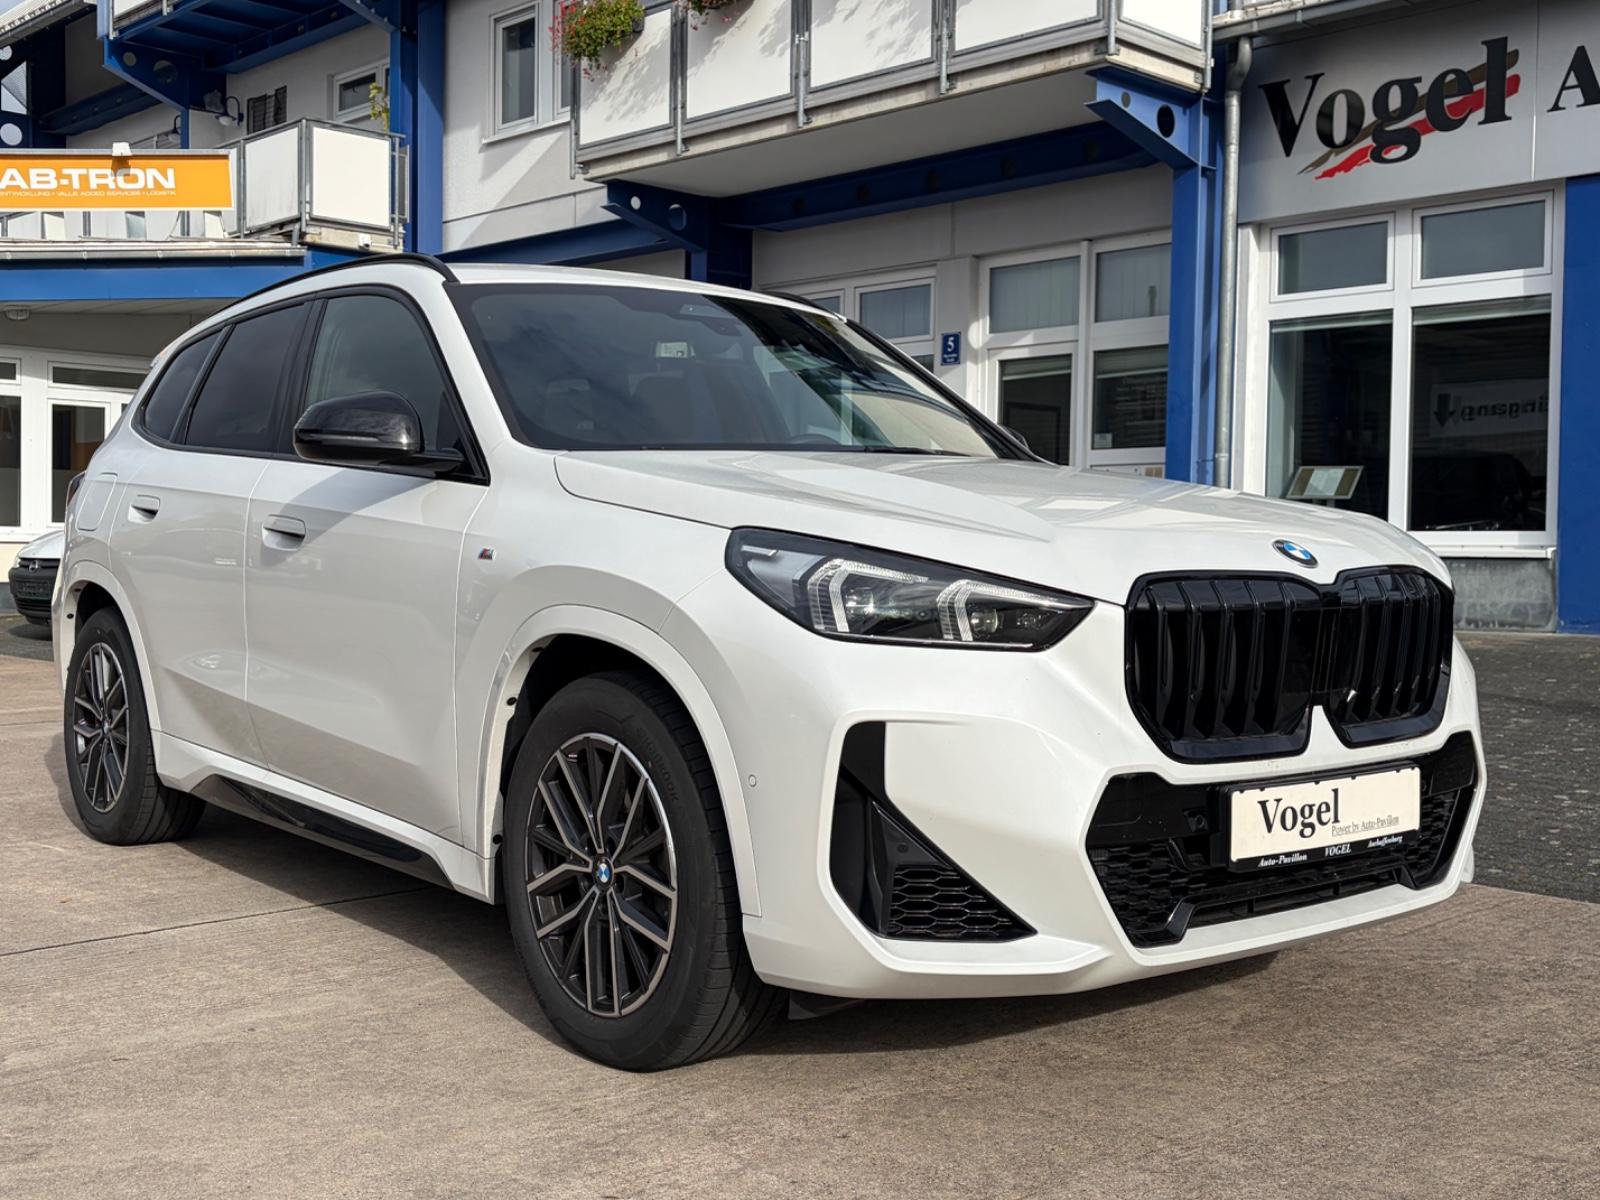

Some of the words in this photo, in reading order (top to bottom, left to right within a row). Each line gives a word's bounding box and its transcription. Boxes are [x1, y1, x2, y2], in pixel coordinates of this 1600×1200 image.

[1258, 36, 1512, 164] Vogel
[1546, 45, 1600, 113] A
[0, 167, 176, 190] AB-TRON
[947, 337, 955, 352] 5
[1257, 787, 1341, 839] Vogel
[1258, 852, 1308, 867] Auto-Pavillon
[1324, 843, 1352, 857] VOGEL
